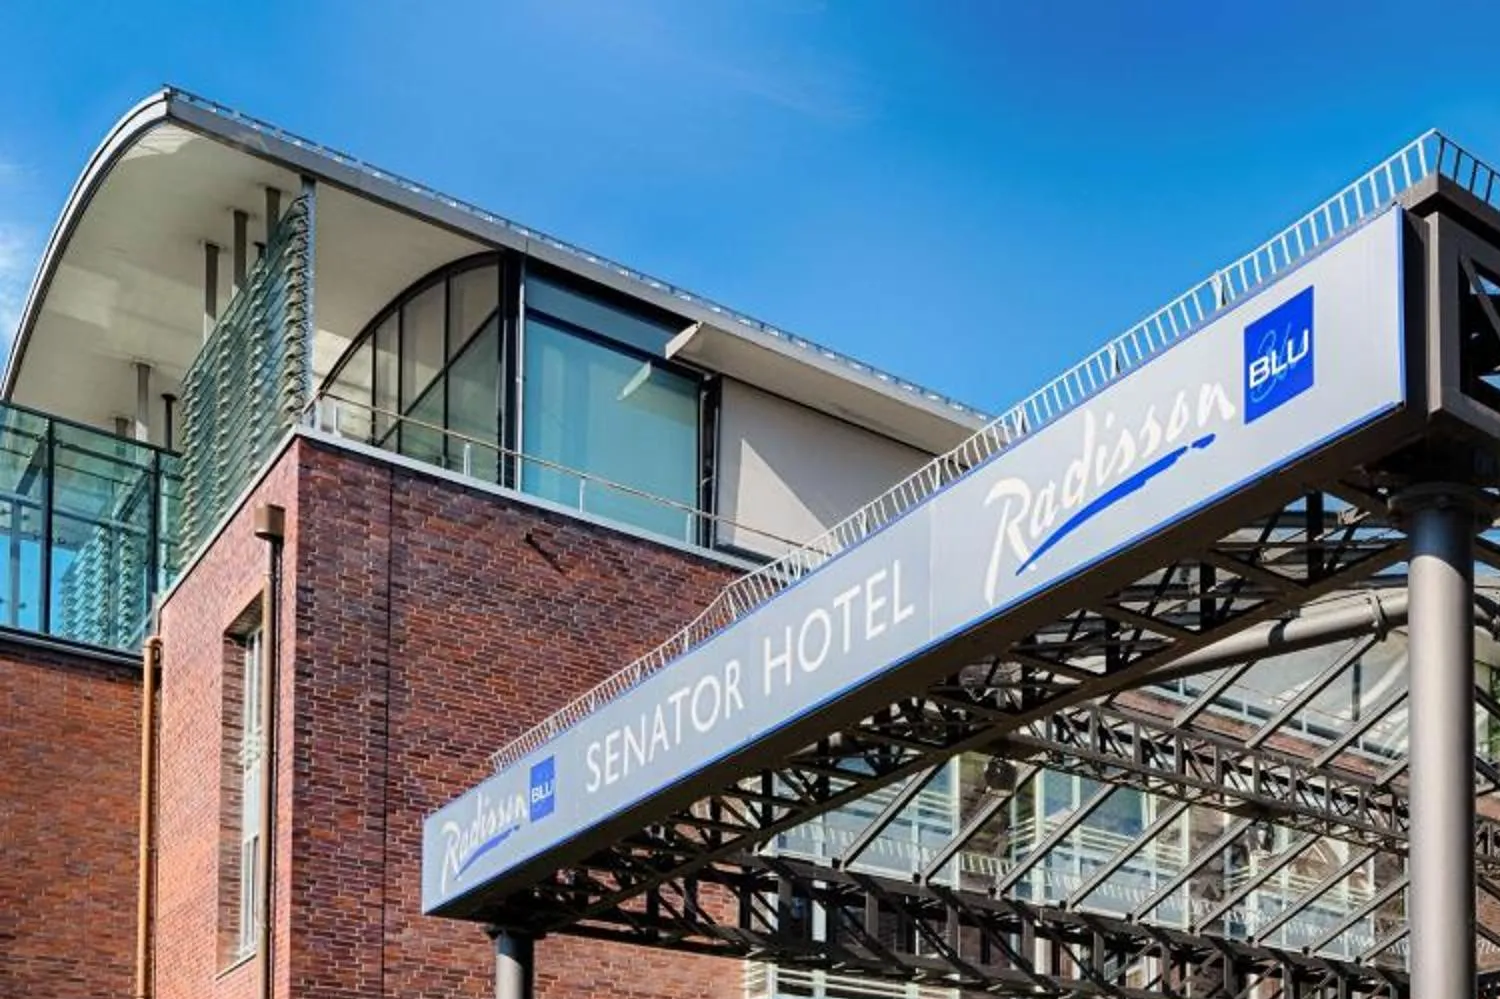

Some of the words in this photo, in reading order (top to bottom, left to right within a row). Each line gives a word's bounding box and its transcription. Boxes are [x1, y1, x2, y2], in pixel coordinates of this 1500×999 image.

[440, 791, 528, 896] Radisson
[586, 660, 744, 793] SENATOR
[763, 559, 914, 696] HOTEL
[984, 381, 1235, 604] Radisson
[1249, 328, 1309, 389] BLU
